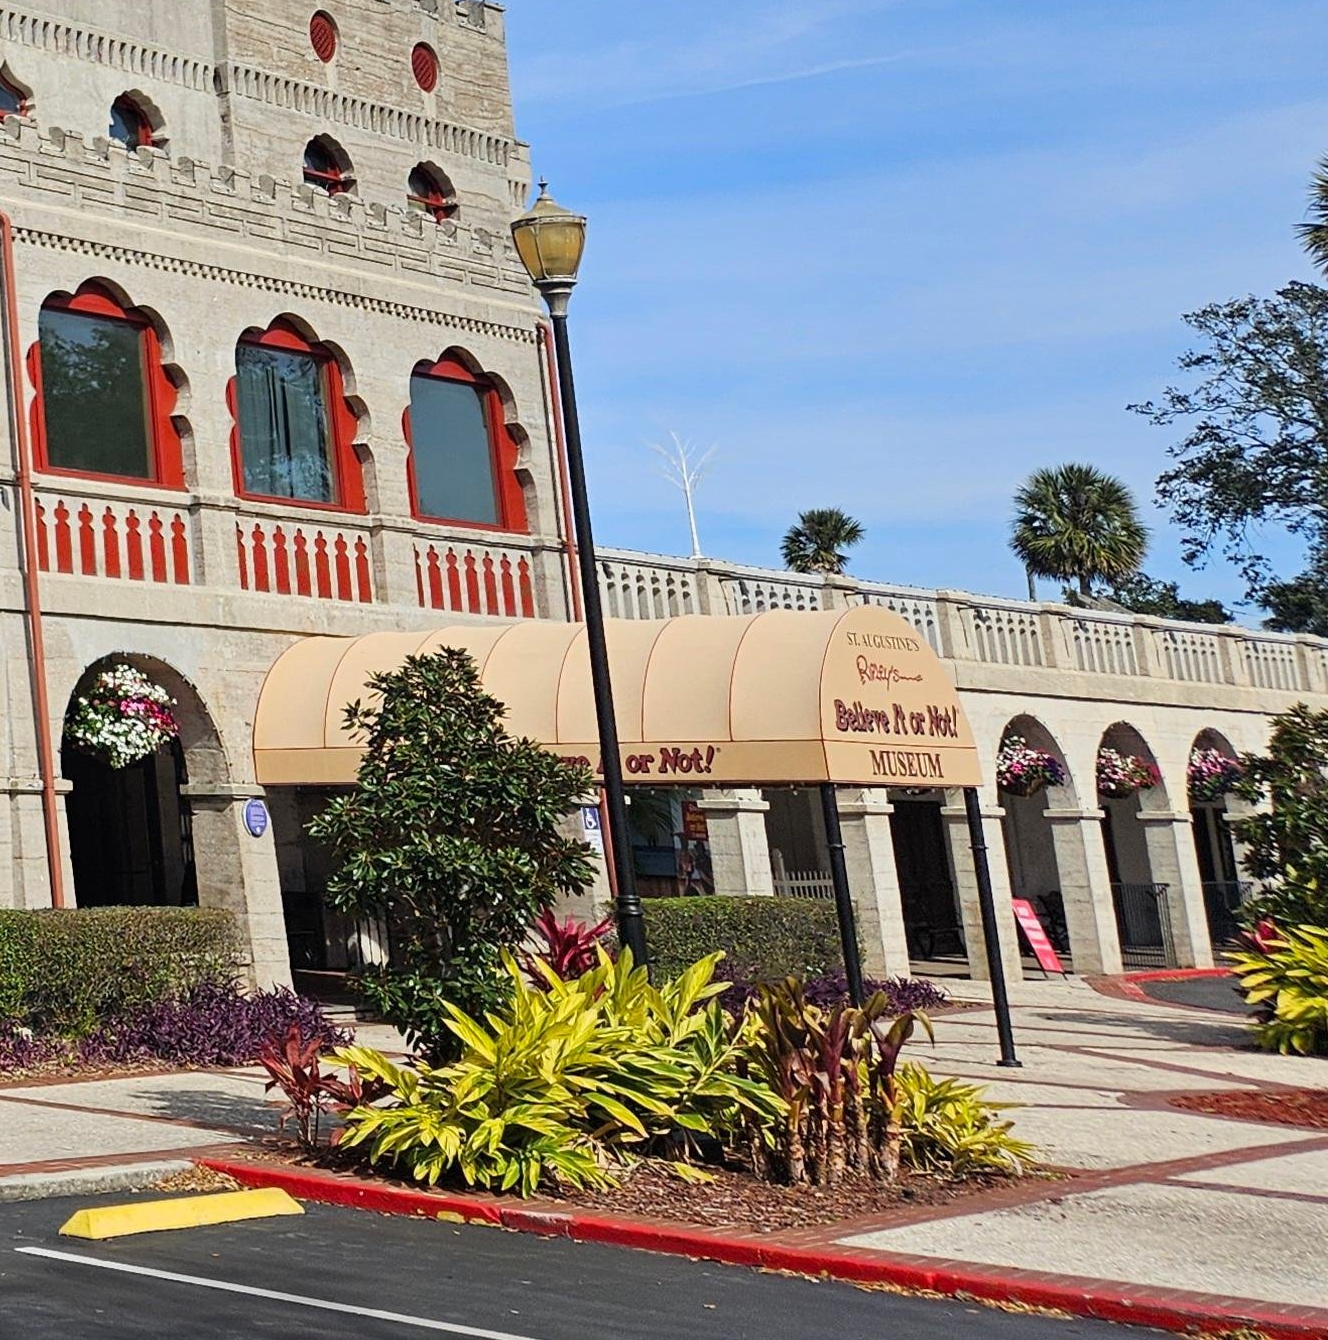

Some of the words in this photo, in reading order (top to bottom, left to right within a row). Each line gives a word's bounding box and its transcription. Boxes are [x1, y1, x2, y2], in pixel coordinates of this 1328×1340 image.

[846, 631, 861, 647] ST.
[862, 633, 920, 652] AUGUSTINE'S
[833, 698, 890, 735] Believe
[892, 702, 908, 736] It
[909, 710, 925, 736] or
[926, 704, 958, 739] Not!
[625, 754, 655, 774] or
[658, 744, 715, 776] Not!
[868, 749, 945, 779] MUSEUM
